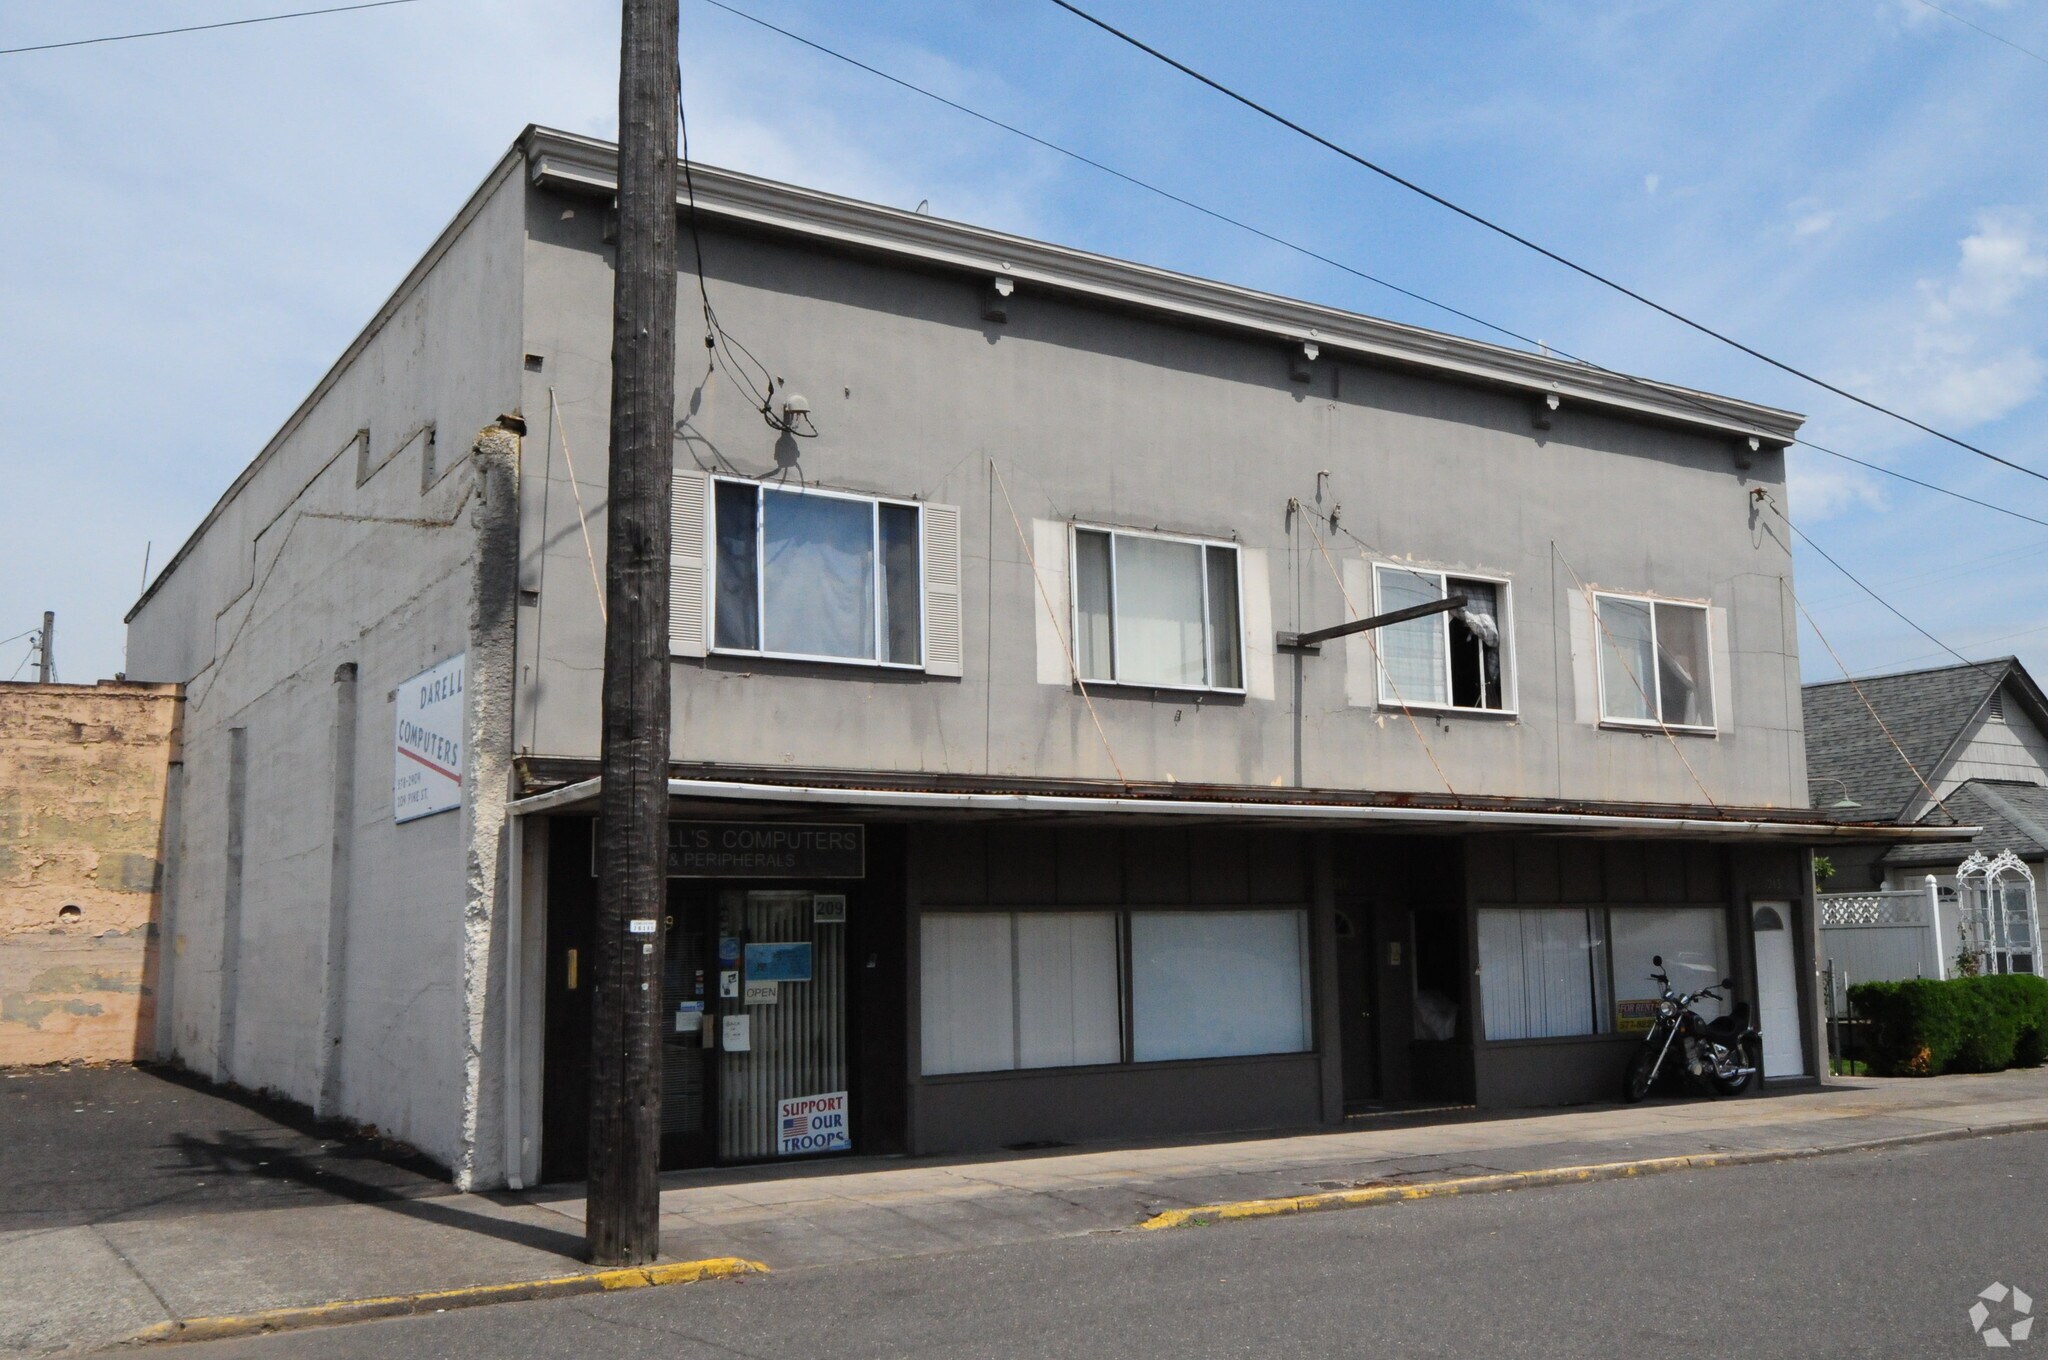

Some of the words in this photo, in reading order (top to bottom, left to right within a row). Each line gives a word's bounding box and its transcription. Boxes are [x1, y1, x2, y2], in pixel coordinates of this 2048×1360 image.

[420, 670, 463, 710] DARELL
[399, 719, 458, 767] COMPUTERS
[722, 830, 856, 850] COMPUTERS
[668, 853, 678, 867] &
[684, 853, 795, 867] PERIPHERALS
[817, 901, 843, 915] 209
[746, 987, 776, 998] OPEN
[1620, 1003, 1635, 1012] FOR
[1635, 1003, 1654, 1012] RENT
[783, 1097, 843, 1117] SUPPORT
[812, 1114, 842, 1130] OUR
[782, 1131, 844, 1152] TROOPS
